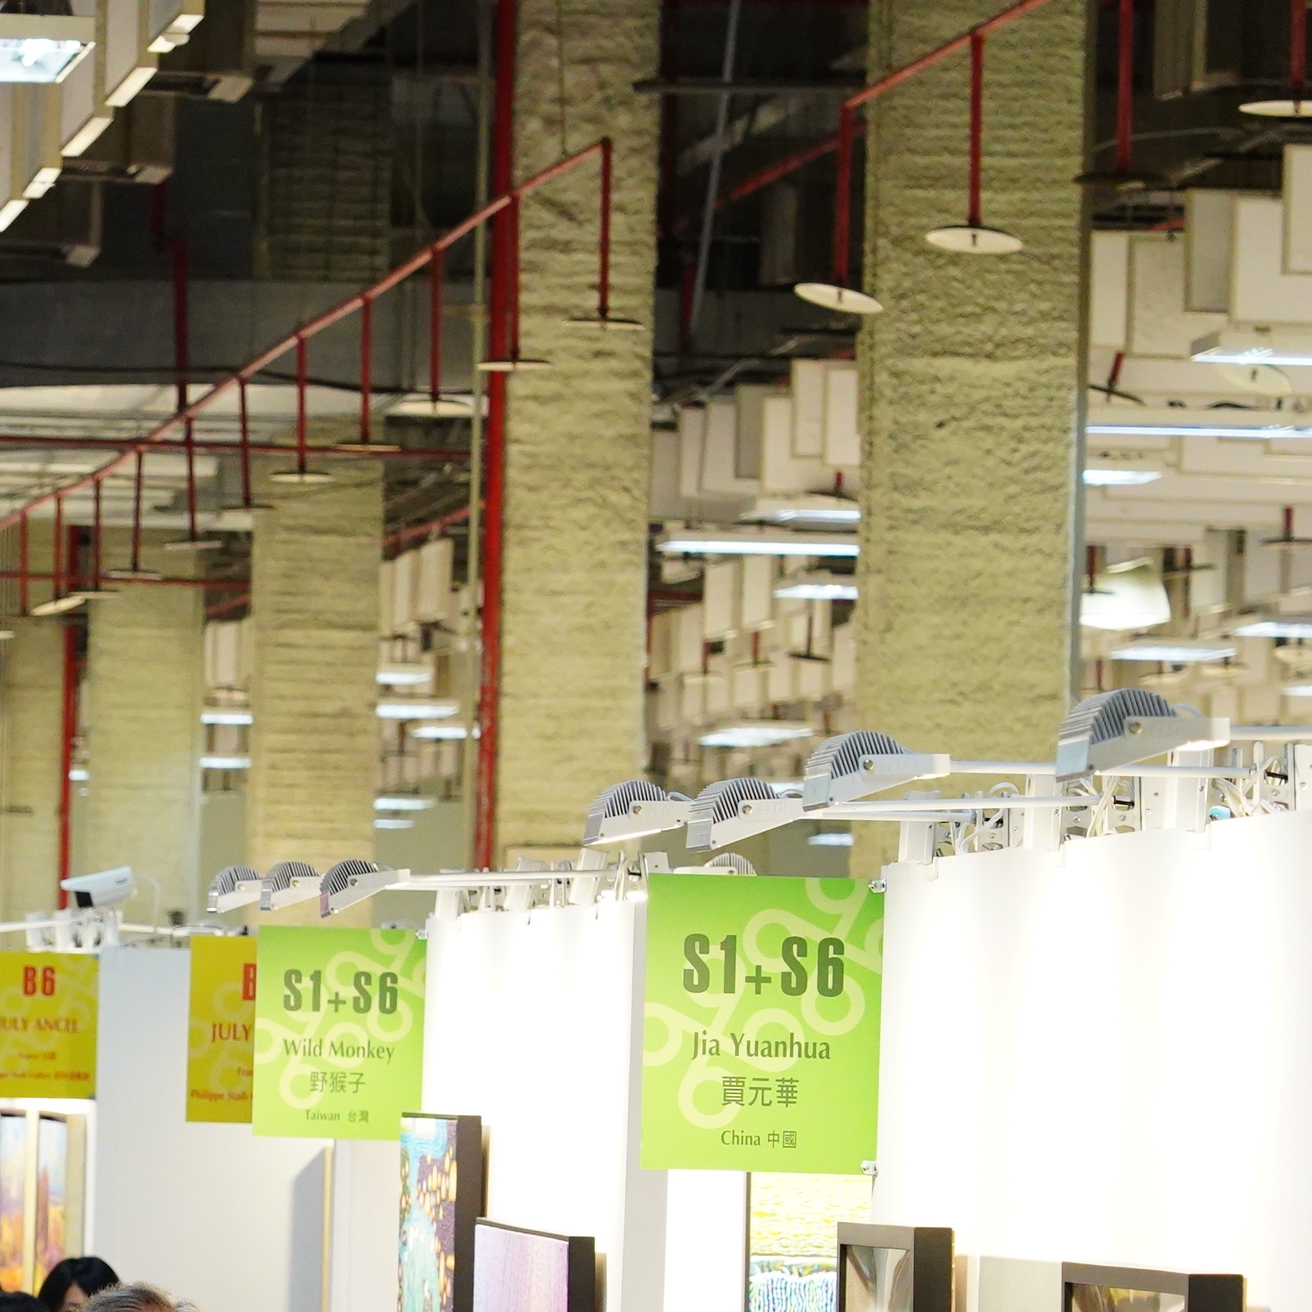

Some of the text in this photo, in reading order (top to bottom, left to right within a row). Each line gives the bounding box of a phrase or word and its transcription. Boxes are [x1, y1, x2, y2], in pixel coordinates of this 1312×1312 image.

[682, 933, 845, 997] S1+S6
[22, 965, 56, 997] B6
[283, 968, 399, 1015] S1+S6
[211, 1022, 253, 1043] JULY
[691, 1029, 832, 1060] Jia Yuanhua
[283, 1038, 395, 1064] Wild Monkey
[309, 1071, 366, 1094] 野猴子
[721, 1075, 800, 1108] 賈元華
[305, 1110, 340, 1122] Taiwan
[721, 1129, 798, 1149] China 中國
